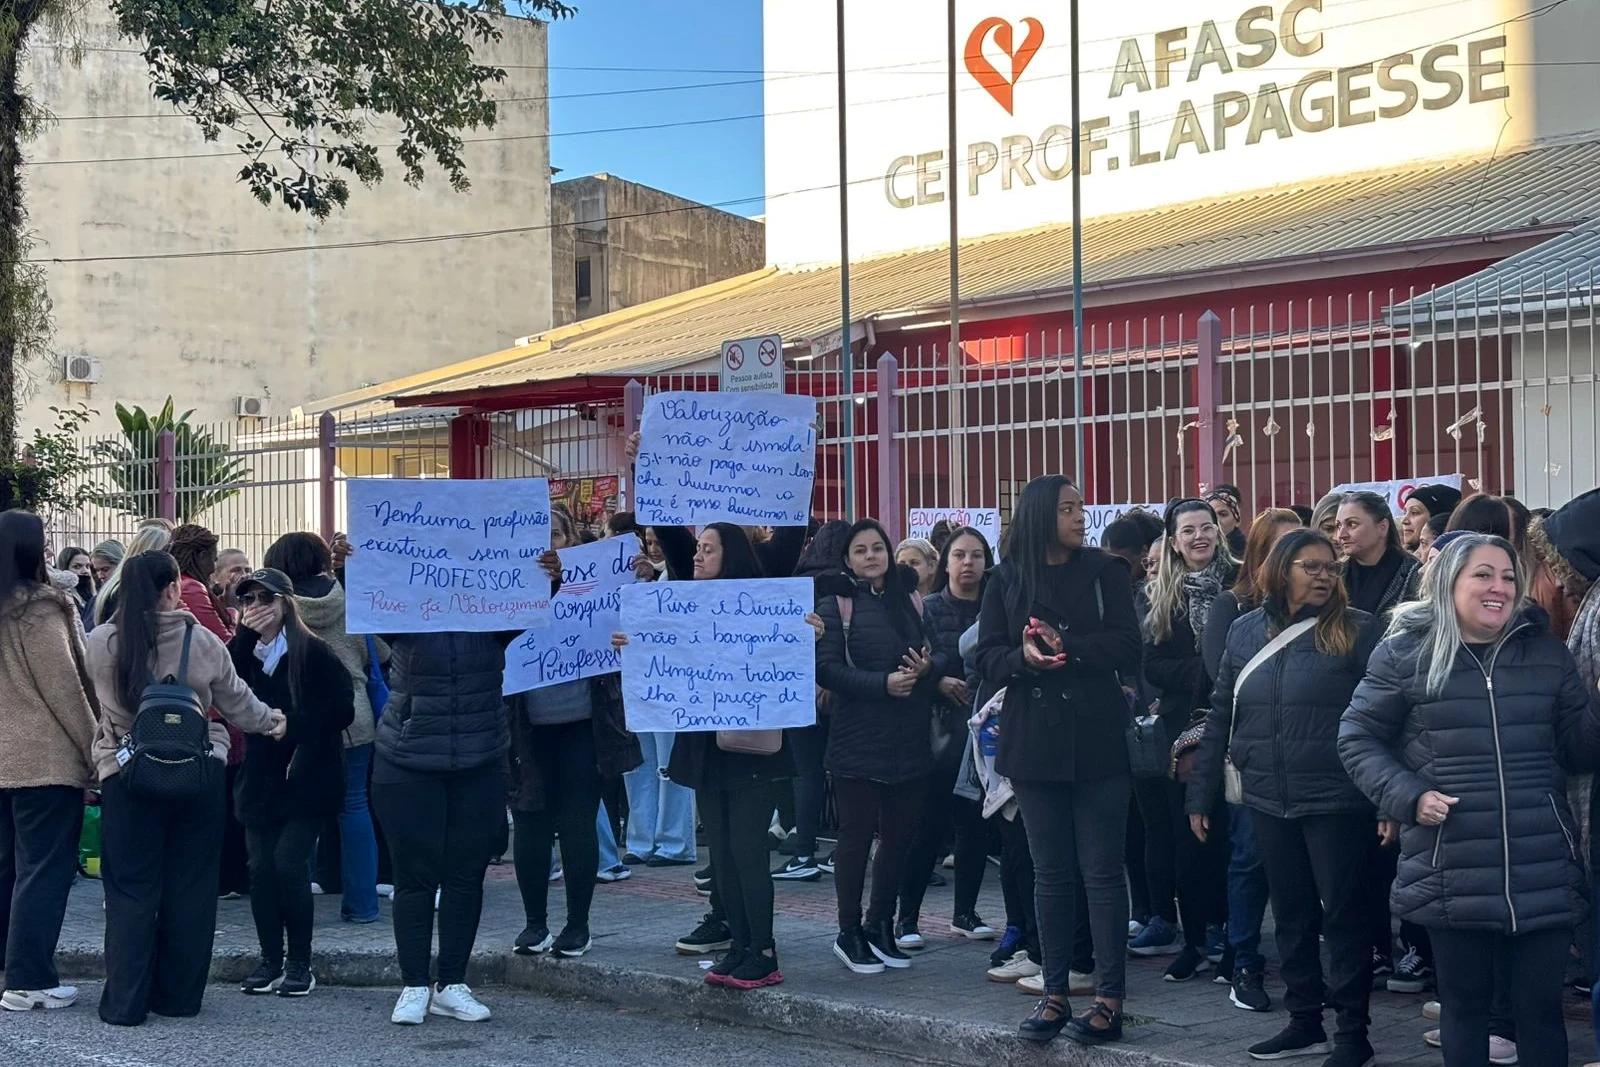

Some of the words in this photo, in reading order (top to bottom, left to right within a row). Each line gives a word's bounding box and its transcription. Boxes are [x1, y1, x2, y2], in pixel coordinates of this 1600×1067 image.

[1108, 0, 1323, 98] AFASC
[885, 150, 945, 209] CE
[730, 374, 752, 383] Pessoa
[753, 371, 774, 381] autista
[661, 399, 788, 437] Valorização
[661, 431, 712, 447] não
[719, 437, 733, 451] é
[742, 428, 811, 453] esmola!
[667, 453, 702, 467] não
[710, 458, 747, 479] paga
[752, 463, 783, 476] um
[636, 497, 664, 512] que
[670, 494, 679, 509] é
[793, 510, 805, 521] o
[776, 490, 794, 501] o
[366, 500, 476, 531] Nenhuma
[484, 510, 549, 538] profissão
[976, 512, 994, 526] DE
[360, 536, 452, 560] existiria
[468, 548, 509, 561] sem
[519, 547, 545, 559] um
[560, 562, 598, 584] ase
[612, 542, 637, 575] de
[646, 587, 700, 614] Piso
[711, 600, 730, 615] é
[520, 633, 537, 650] é
[560, 634, 580, 648] o
[633, 631, 677, 646] não
[689, 630, 701, 644] é
[644, 655, 733, 691] Ninguém
[641, 684, 677, 702] lha
[713, 690, 767, 711] preço
[779, 687, 804, 703] de
[671, 705, 760, 729] Banana!
